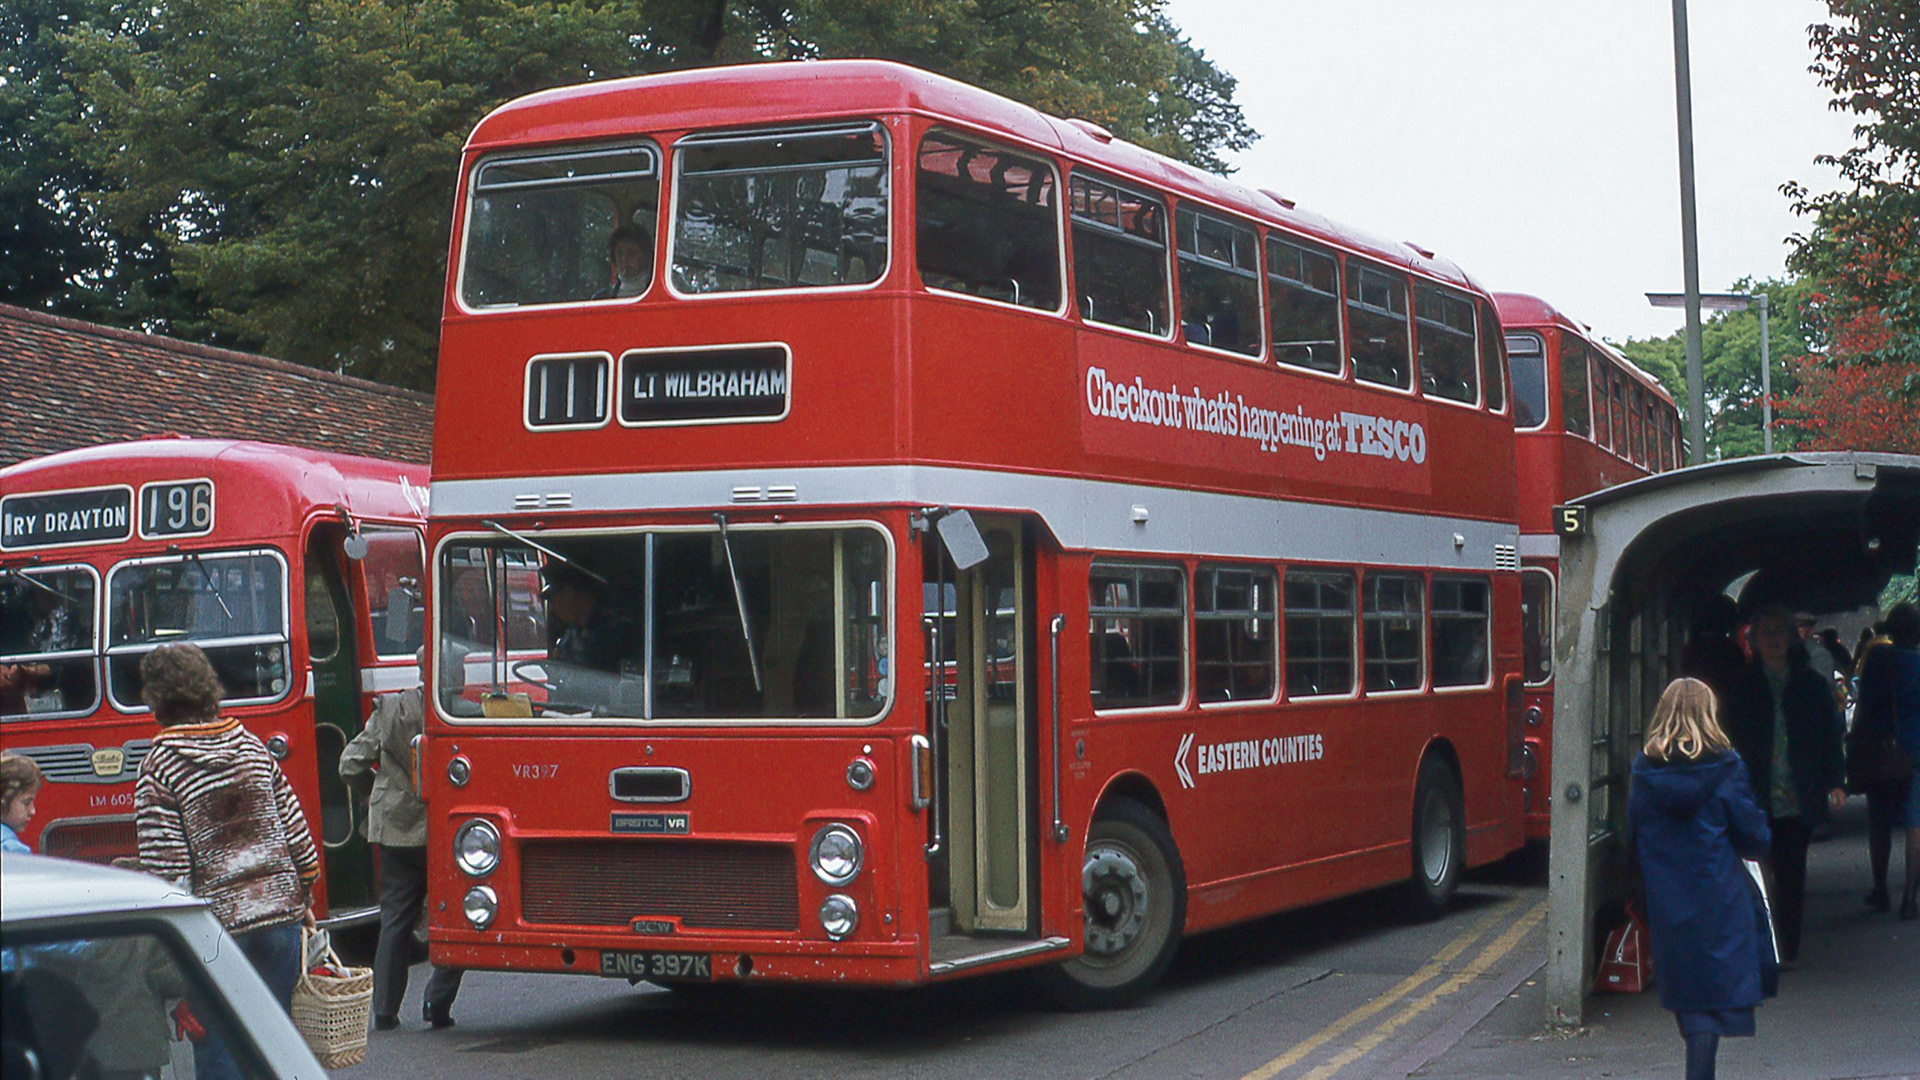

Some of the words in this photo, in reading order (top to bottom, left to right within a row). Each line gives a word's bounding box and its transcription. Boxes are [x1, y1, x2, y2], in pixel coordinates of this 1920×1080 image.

[539, 362, 605, 420] 111
[633, 374, 658, 399] LT
[664, 369, 786, 398] WILBRAHAM
[1086, 365, 1182, 430] Checkout
[1181, 386, 1239, 437] what's
[1236, 394, 1326, 462] happening
[1325, 413, 1342, 452] at
[1339, 411, 1427, 465] TESCO
[44, 505, 126, 533] DRAYTON
[149, 484, 211, 530] 196
[1563, 509, 1579, 532] 5
[1197, 740, 1260, 775] EASTERN
[1261, 733, 1324, 767] COUNTIES
[512, 764, 559, 779] VR397
[90, 794, 107, 807] LM
[615, 818, 662, 828] BRISTOL
[635, 921, 671, 932] ECW
[601, 952, 646, 975] ENG
[651, 953, 710, 977] 397K
